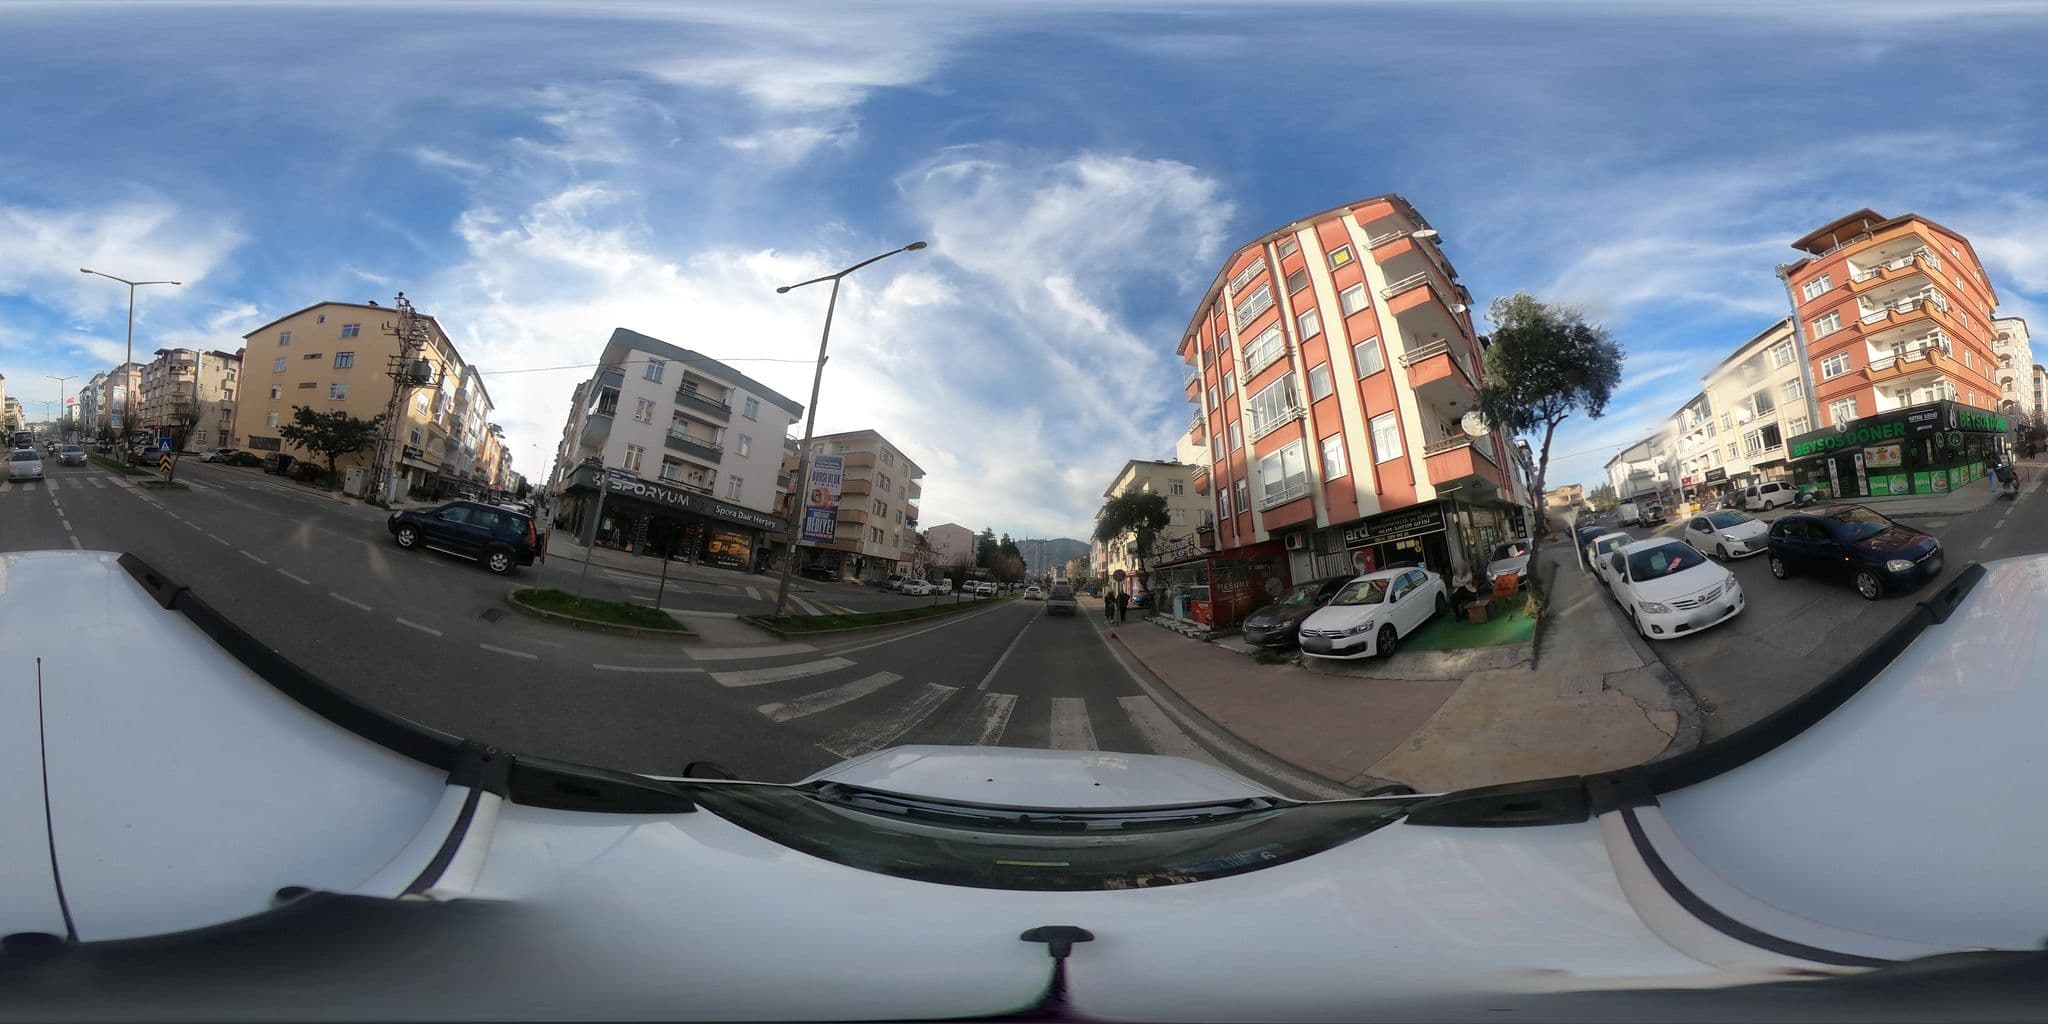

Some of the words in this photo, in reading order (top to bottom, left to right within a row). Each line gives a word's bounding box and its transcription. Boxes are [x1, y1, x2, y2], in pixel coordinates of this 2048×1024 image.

[1793, 434, 1845, 457] BEYSOS
[1850, 421, 1905, 445] DÖNER
[611, 480, 690, 507] SPORYUM
[715, 505, 737, 518] Spora
[738, 510, 753, 521] Dair
[1345, 522, 1370, 541] ard
